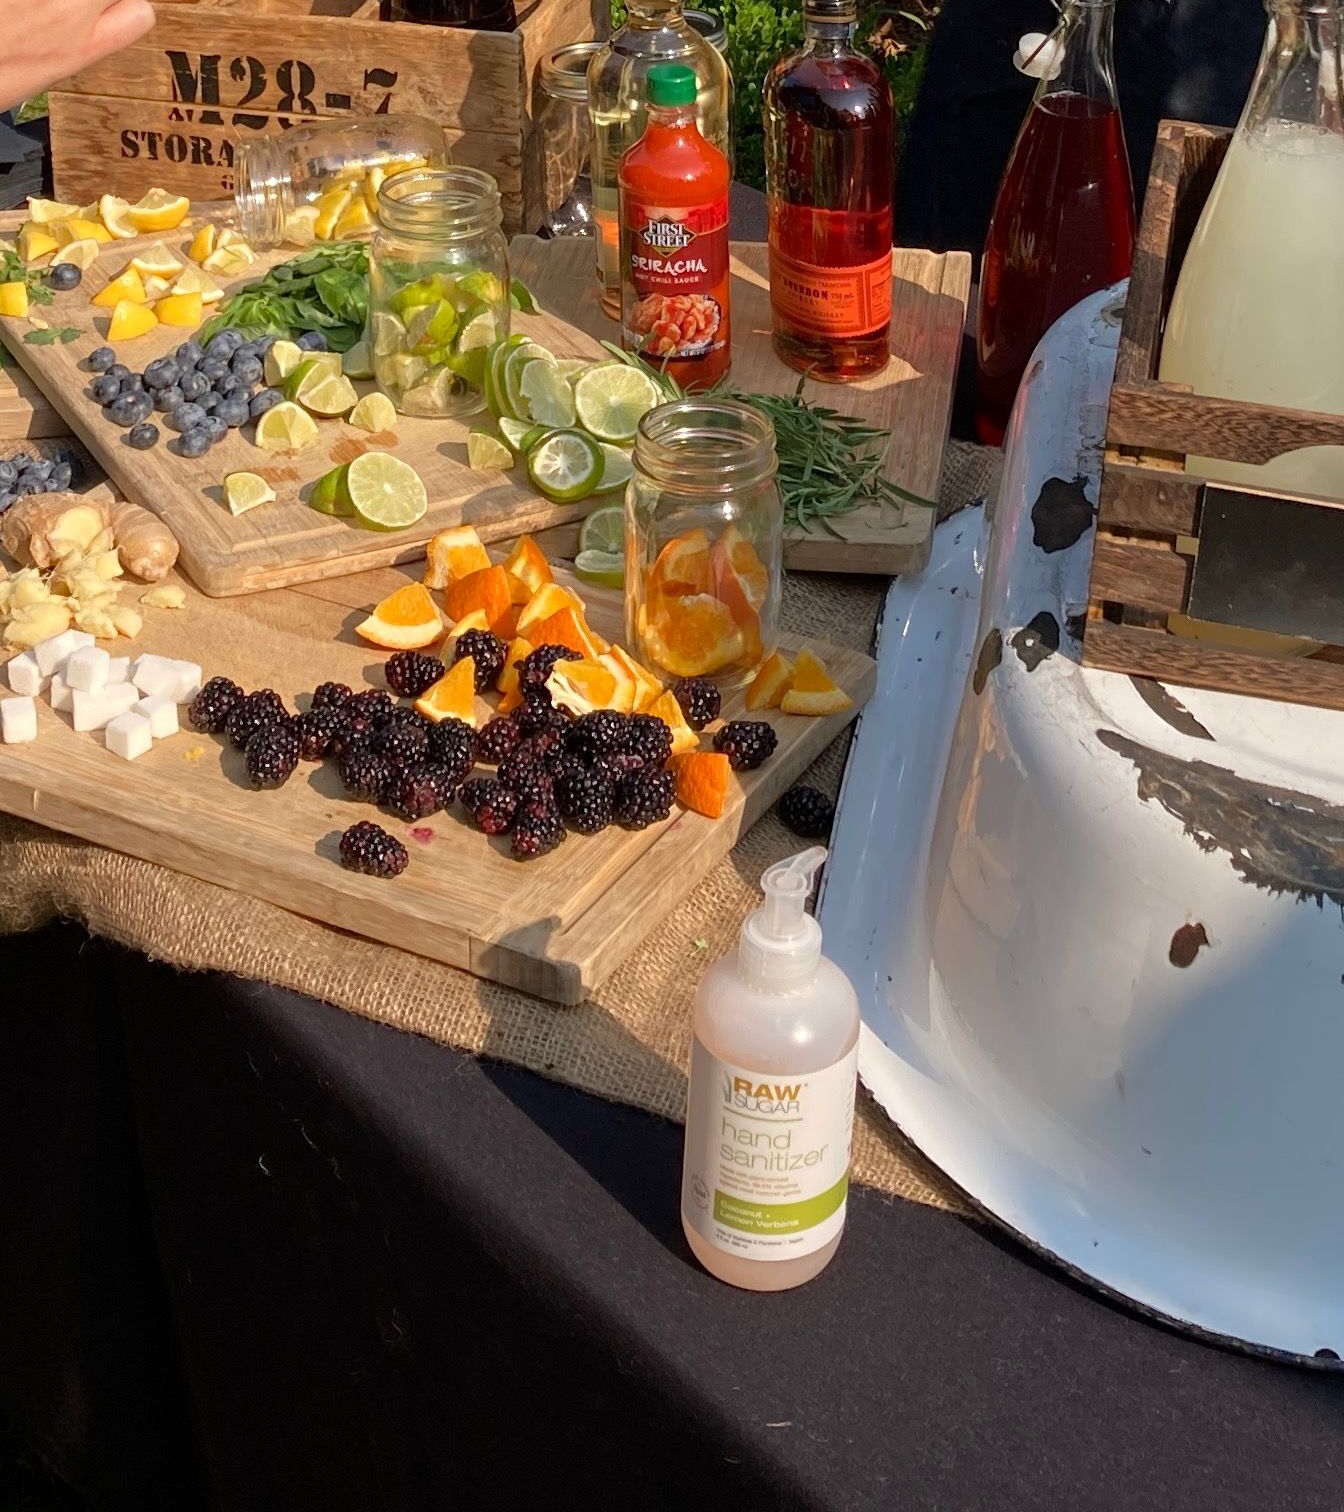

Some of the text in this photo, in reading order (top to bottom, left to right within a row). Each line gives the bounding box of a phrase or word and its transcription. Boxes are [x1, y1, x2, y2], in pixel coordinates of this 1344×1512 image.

[164, 50, 399, 129] M28-7
[120, 128, 234, 168] STORA
[648, 219, 686, 236] FIRST
[643, 232, 690, 247] STREET
[631, 254, 708, 276] SRIRACHA
[674, 276, 699, 284] SAUCE
[734, 1076, 801, 1101] RAW
[734, 1093, 800, 1114] SUGAR
[721, 1116, 791, 1149] hand
[720, 1144, 829, 1172] sanitizer
